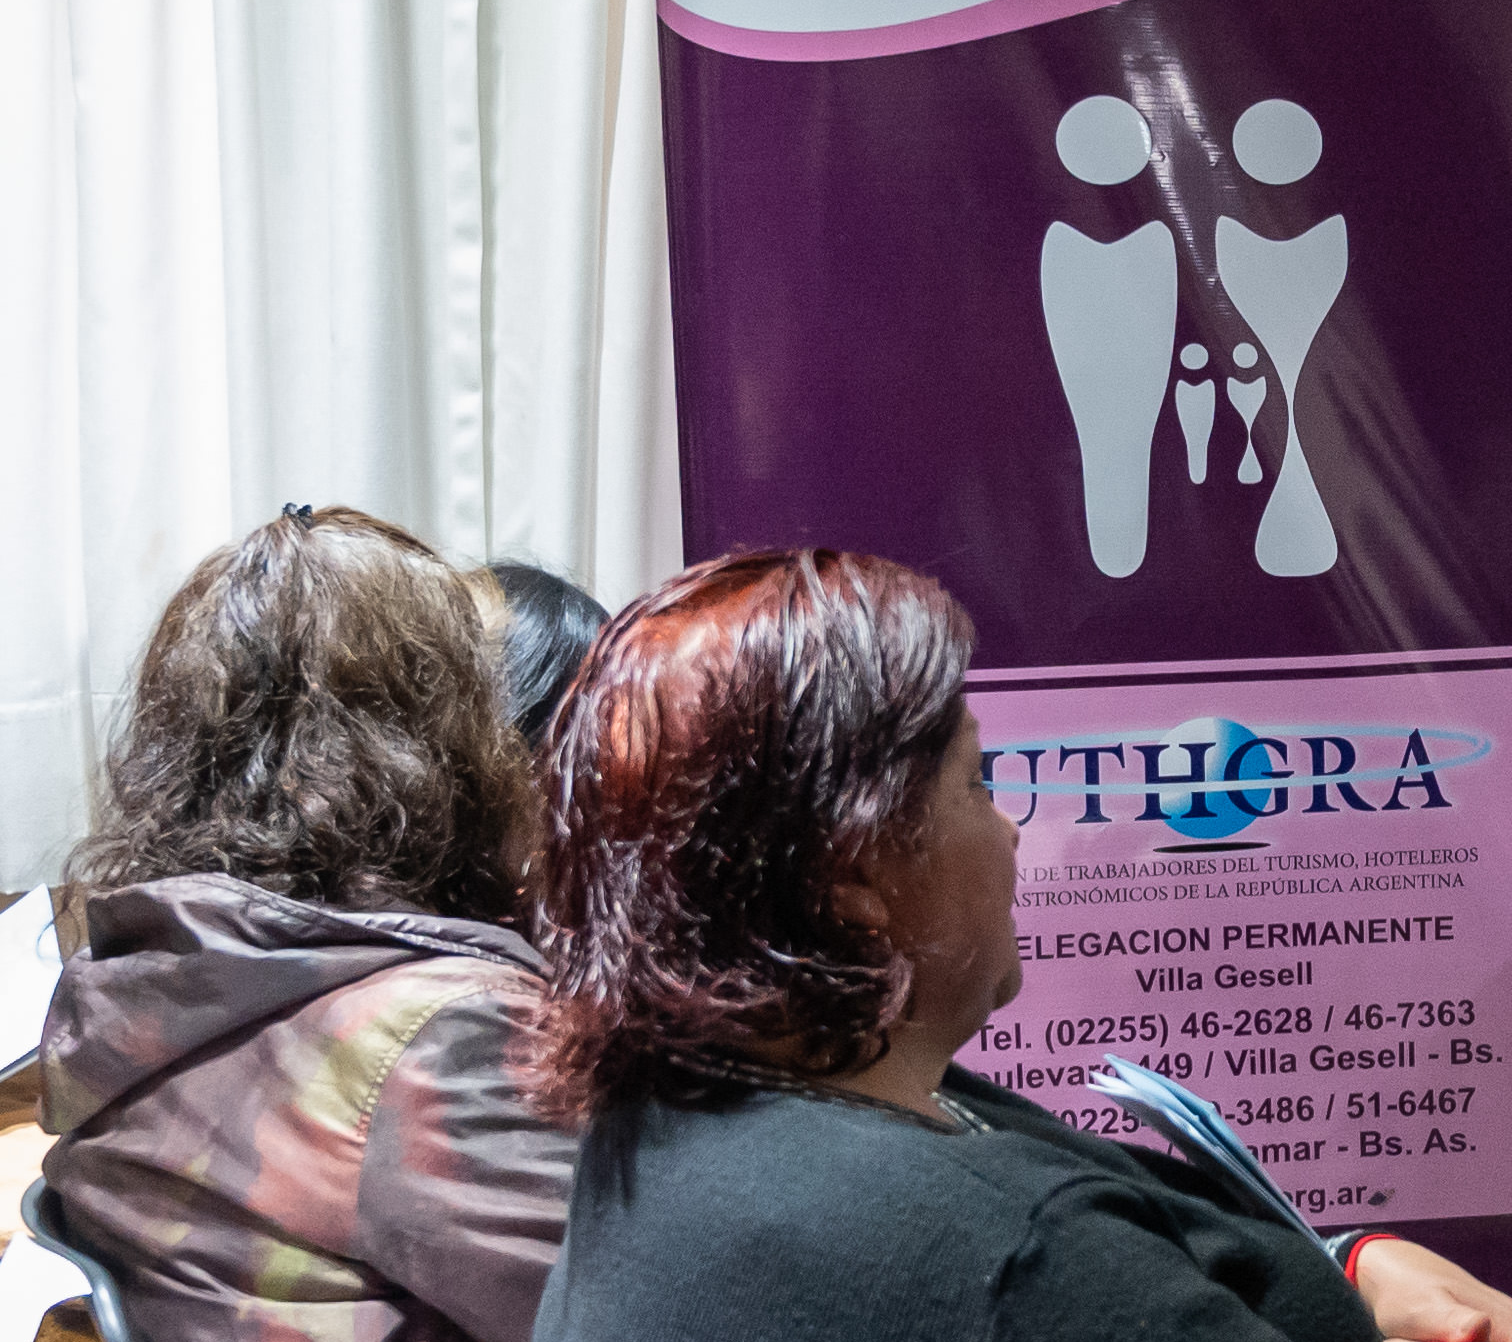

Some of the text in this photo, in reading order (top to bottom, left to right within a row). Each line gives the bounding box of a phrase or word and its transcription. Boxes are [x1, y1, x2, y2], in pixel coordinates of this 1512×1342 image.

[982, 727, 1453, 827] UTHGRA
[1032, 865, 1061, 883] DE
[1064, 859, 1218, 883] TRABAJADORES
[1222, 856, 1261, 875] DEL
[1266, 852, 1360, 872] TURISMO,
[1363, 846, 1480, 868] HOTELEROS
[1012, 871, 1466, 908] STRONÓMICOS DE LA REPÚBLICA ARGENTINA
[1014, 916, 1456, 962] ELEGACION PERMANENTE
[1135, 961, 1314, 994] Villa Gesell
[977, 999, 1477, 1055] Tel. (02255) 46-2628 / 46-7363
[1204, 1050, 1216, 1078] /
[1223, 1044, 1298, 1076] Villa
[1308, 1039, 1417, 1072] Gesell
[1449, 1037, 1504, 1065] Bs.
[1212, 1095, 1316, 1127] -3486
[1324, 1093, 1336, 1122] /
[1345, 1087, 1477, 1119] 51-6467
[1359, 1129, 1413, 1159] Bs.
[1422, 1127, 1478, 1156] As.
[1283, 1184, 1368, 1214] rg.ar
